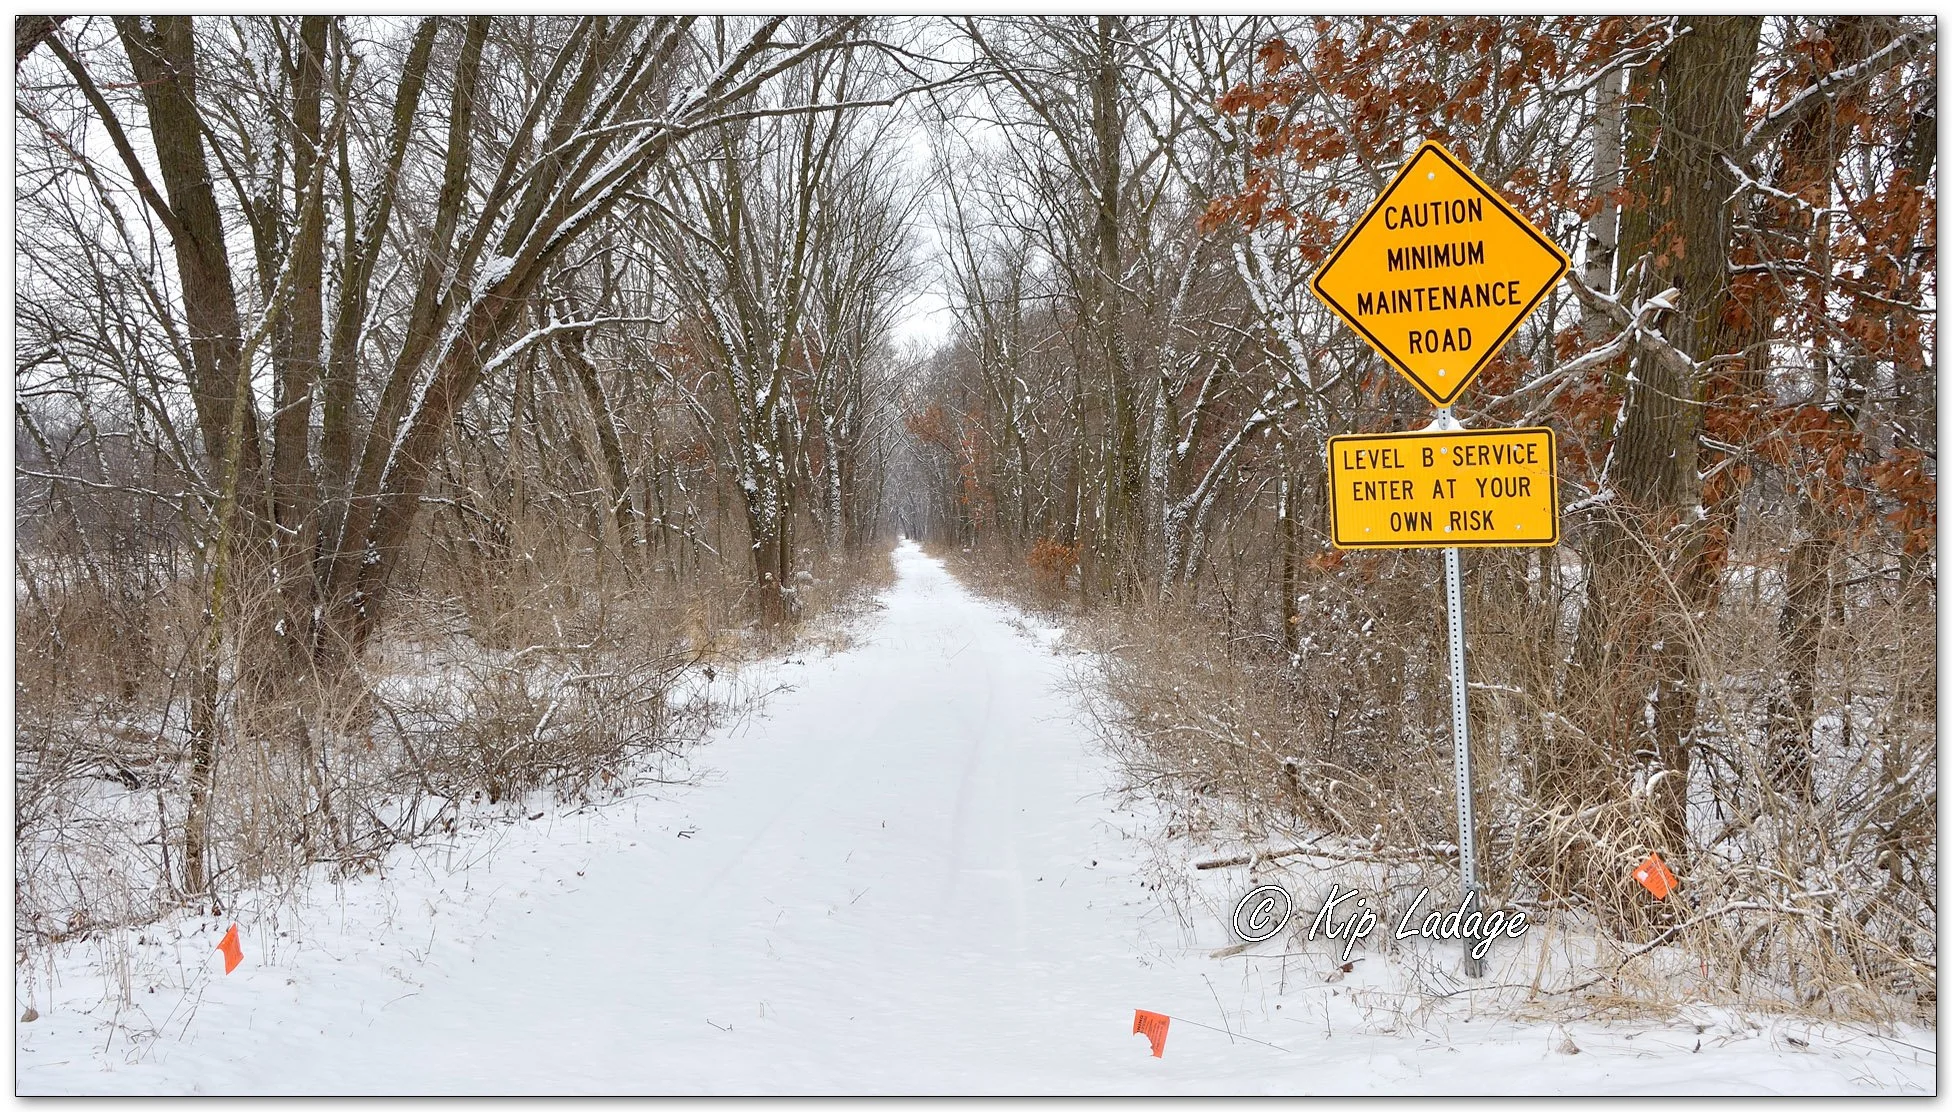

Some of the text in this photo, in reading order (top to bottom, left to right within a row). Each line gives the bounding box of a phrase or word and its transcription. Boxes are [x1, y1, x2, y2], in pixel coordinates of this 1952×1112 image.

[1384, 198, 1483, 230] CAUTION
[1387, 241, 1484, 272] MINIMUM
[1357, 281, 1521, 316] MAINTENANCE
[1408, 327, 1472, 355] ROAD
[1343, 443, 1538, 470] LEVEL B SERVICE
[1353, 476, 1531, 501] ENTER AT YOUR
[1390, 510, 1495, 532] OWN RISK
